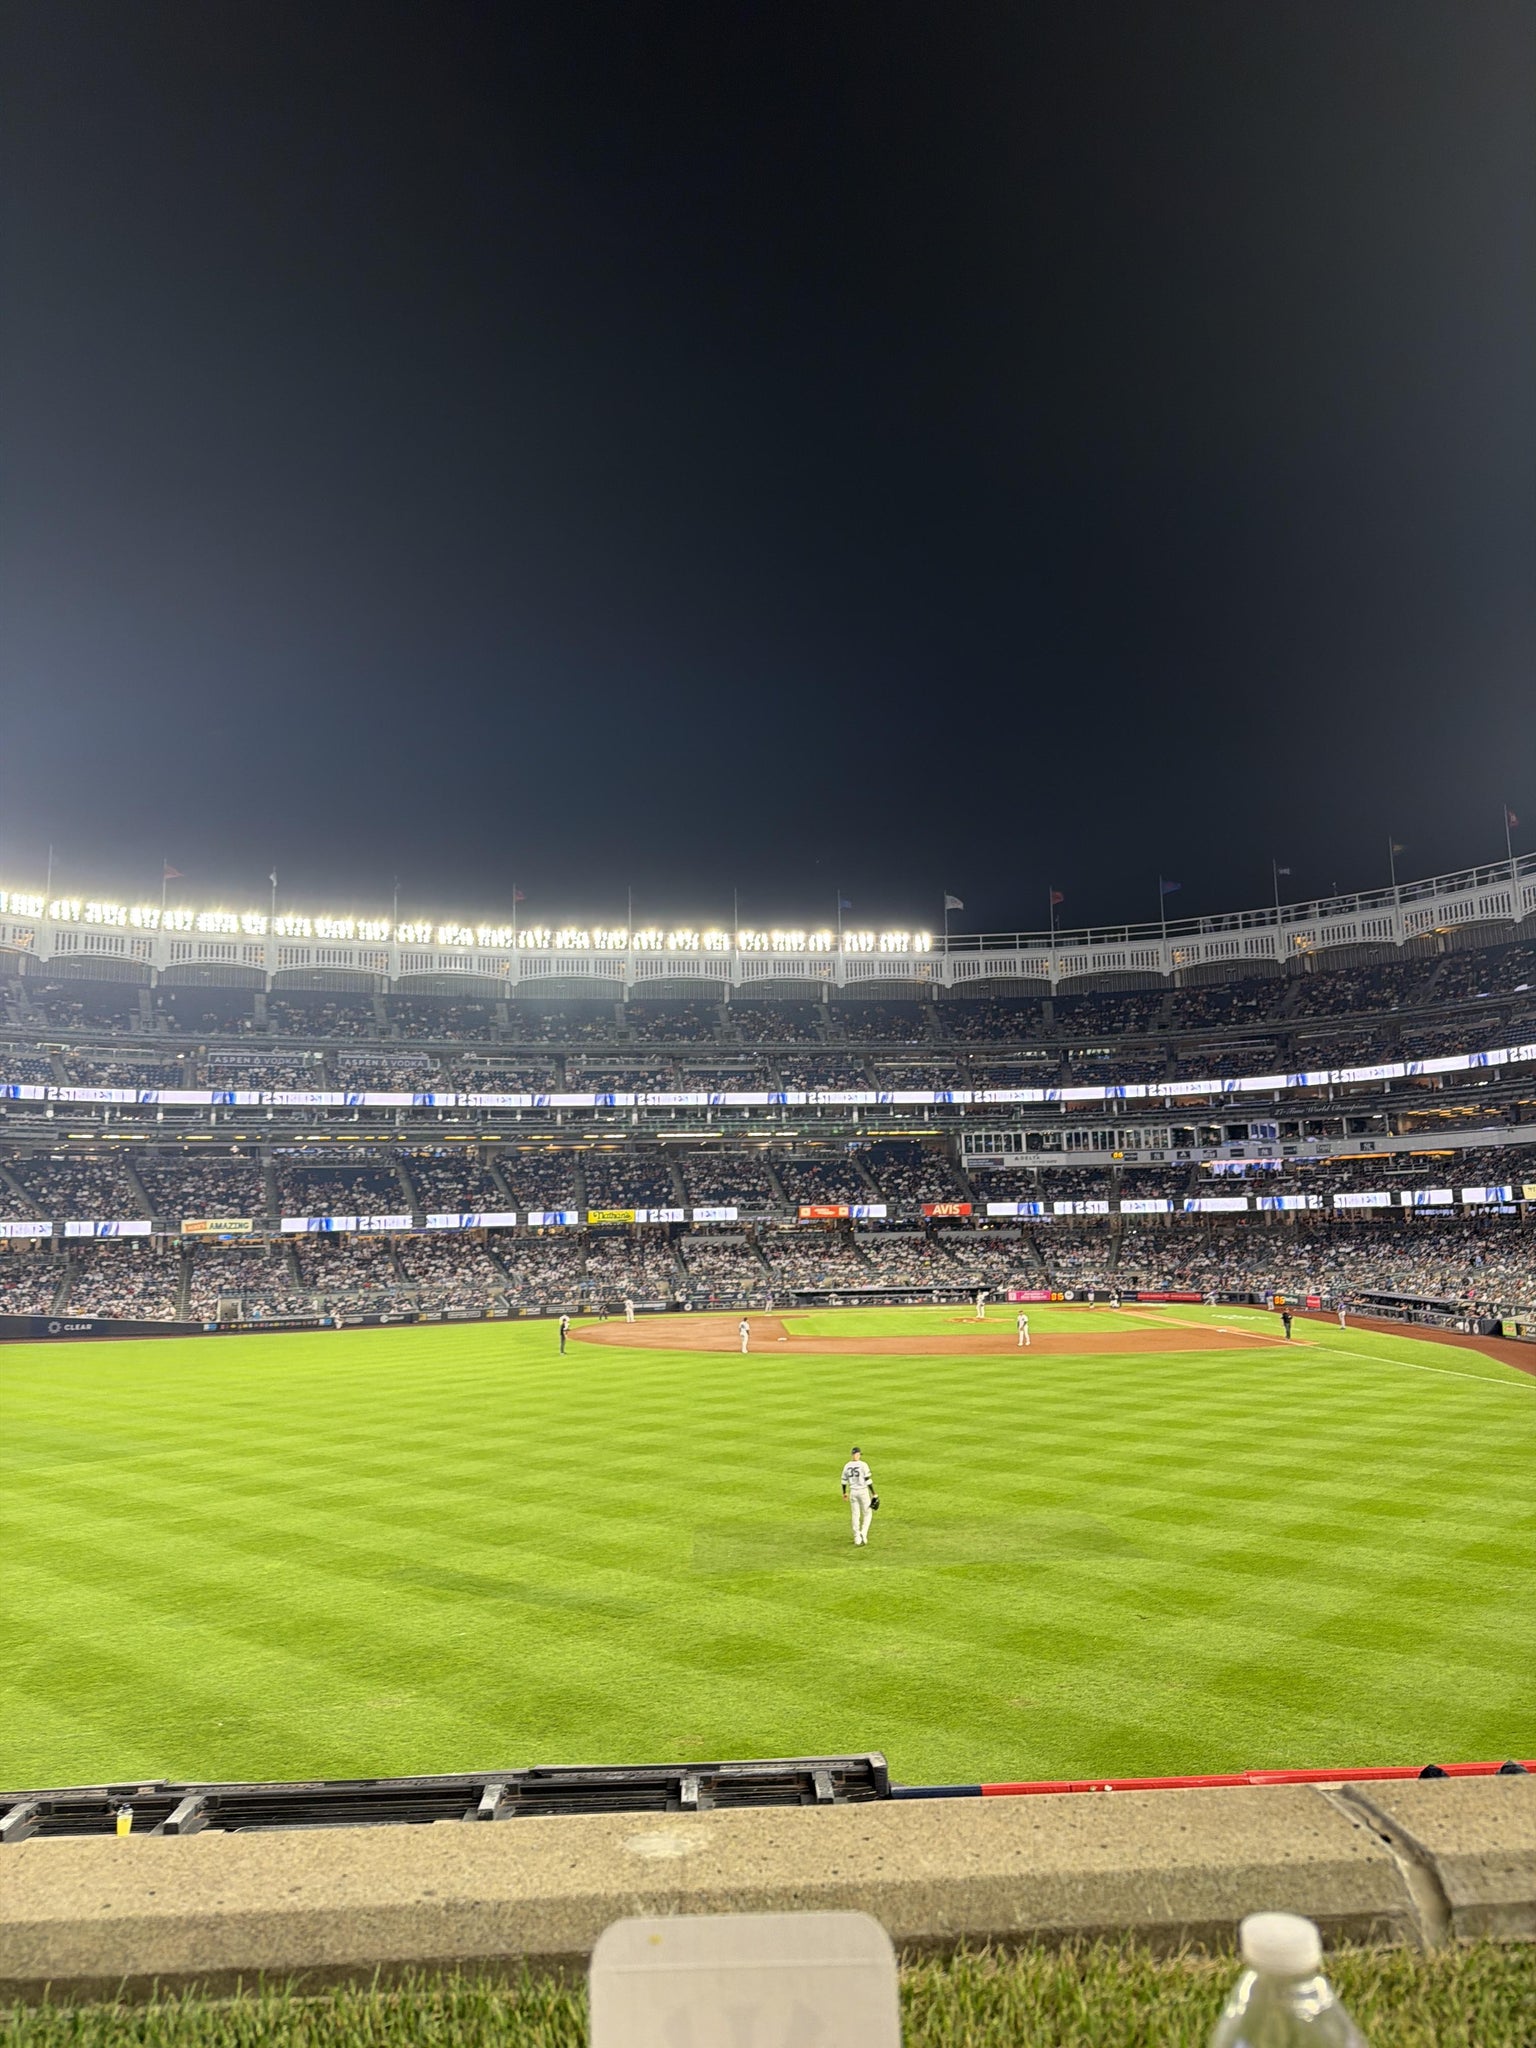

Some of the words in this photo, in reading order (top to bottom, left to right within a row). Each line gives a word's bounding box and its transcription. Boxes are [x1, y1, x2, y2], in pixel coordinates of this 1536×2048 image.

[214, 1056, 250, 1064] ASPEN
[263, 1057, 300, 1065] VODKA
[344, 1059, 379, 1067] ASPEN
[390, 1060, 425, 1068] VODKA
[1306, 1104, 1330, 1113] World
[932, 1204, 961, 1215] AVIS
[208, 1221, 250, 1230] AMAZING
[63, 1323, 93, 1331] CLEAR
[847, 1466, 861, 1478] 35
